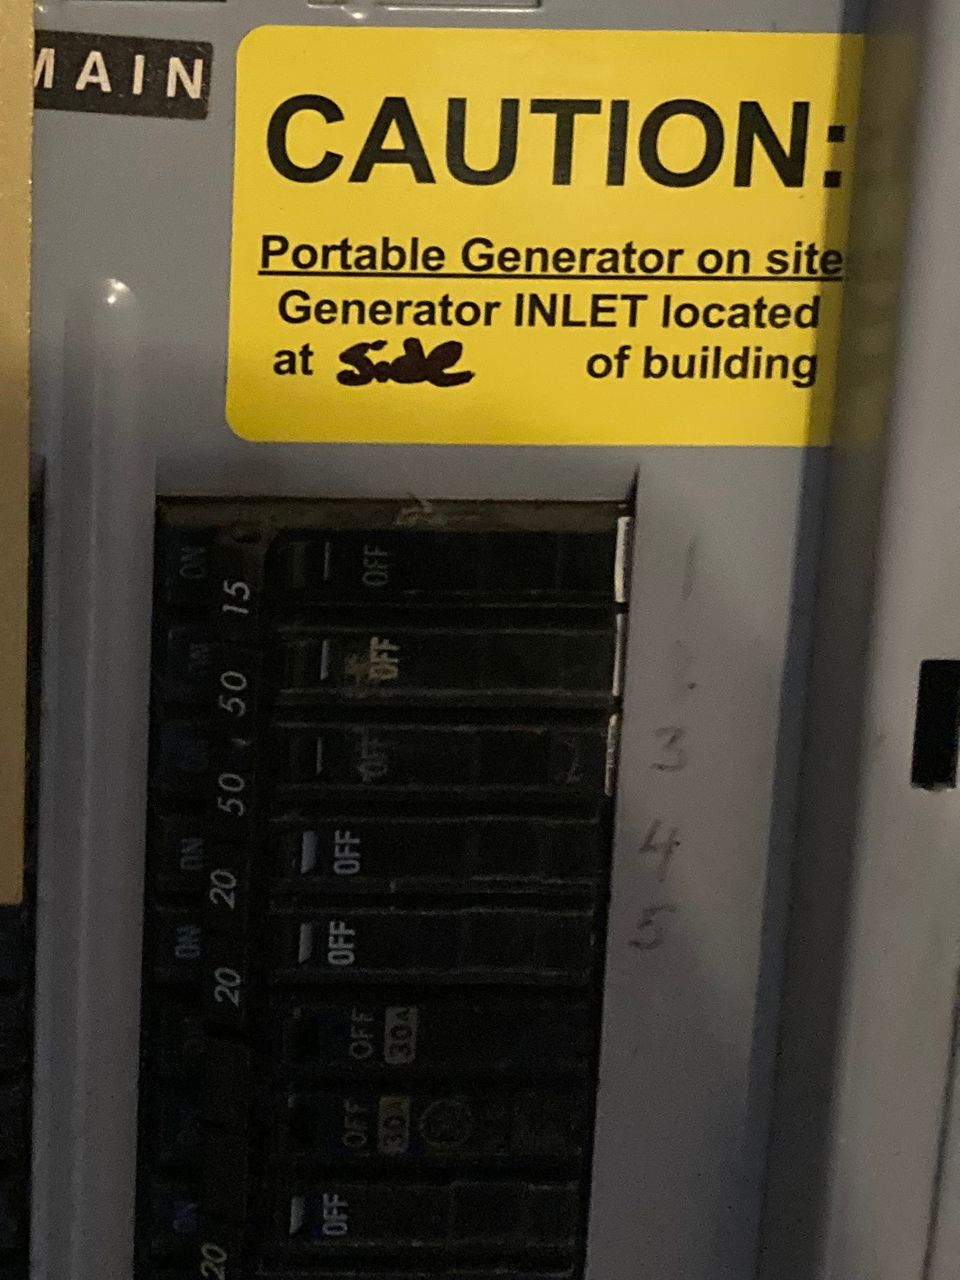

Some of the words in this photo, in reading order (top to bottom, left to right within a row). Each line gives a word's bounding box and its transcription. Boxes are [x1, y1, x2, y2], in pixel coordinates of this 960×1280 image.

[266, 93, 847, 189] CAUTION:
[259, 233, 446, 271] Portable
[461, 237, 685, 275] Generator
[697, 246, 753, 275] on
[765, 241, 845, 276] site
[277, 289, 502, 327] Generator
[514, 293, 648, 328] INLET
[661, 295, 821, 329] located
[273, 344, 314, 375] at
[586, 345, 630, 379] of
[643, 344, 819, 388] building
[362, 542, 390, 587] OFF
[221, 579, 251, 615] 15
[369, 636, 401, 681] OFF
[217, 671, 248, 717] 50
[649, 726, 688, 772] 3
[217, 773, 247, 816] 50
[179, 837, 205, 871] ON
[333, 829, 361, 875] OFF
[639, 819, 680, 883] 4
[209, 869, 238, 911] 20
[174, 925, 200, 960] ON
[327, 920, 356, 966] OFF
[628, 904, 678, 951] 5
[214, 967, 242, 1007] 20
[348, 1008, 375, 1060] OFF
[385, 1007, 414, 1062] 30A
[342, 1099, 369, 1148] OFF
[322, 1192, 349, 1237] OFF
[200, 1242, 228, 1280] 20
